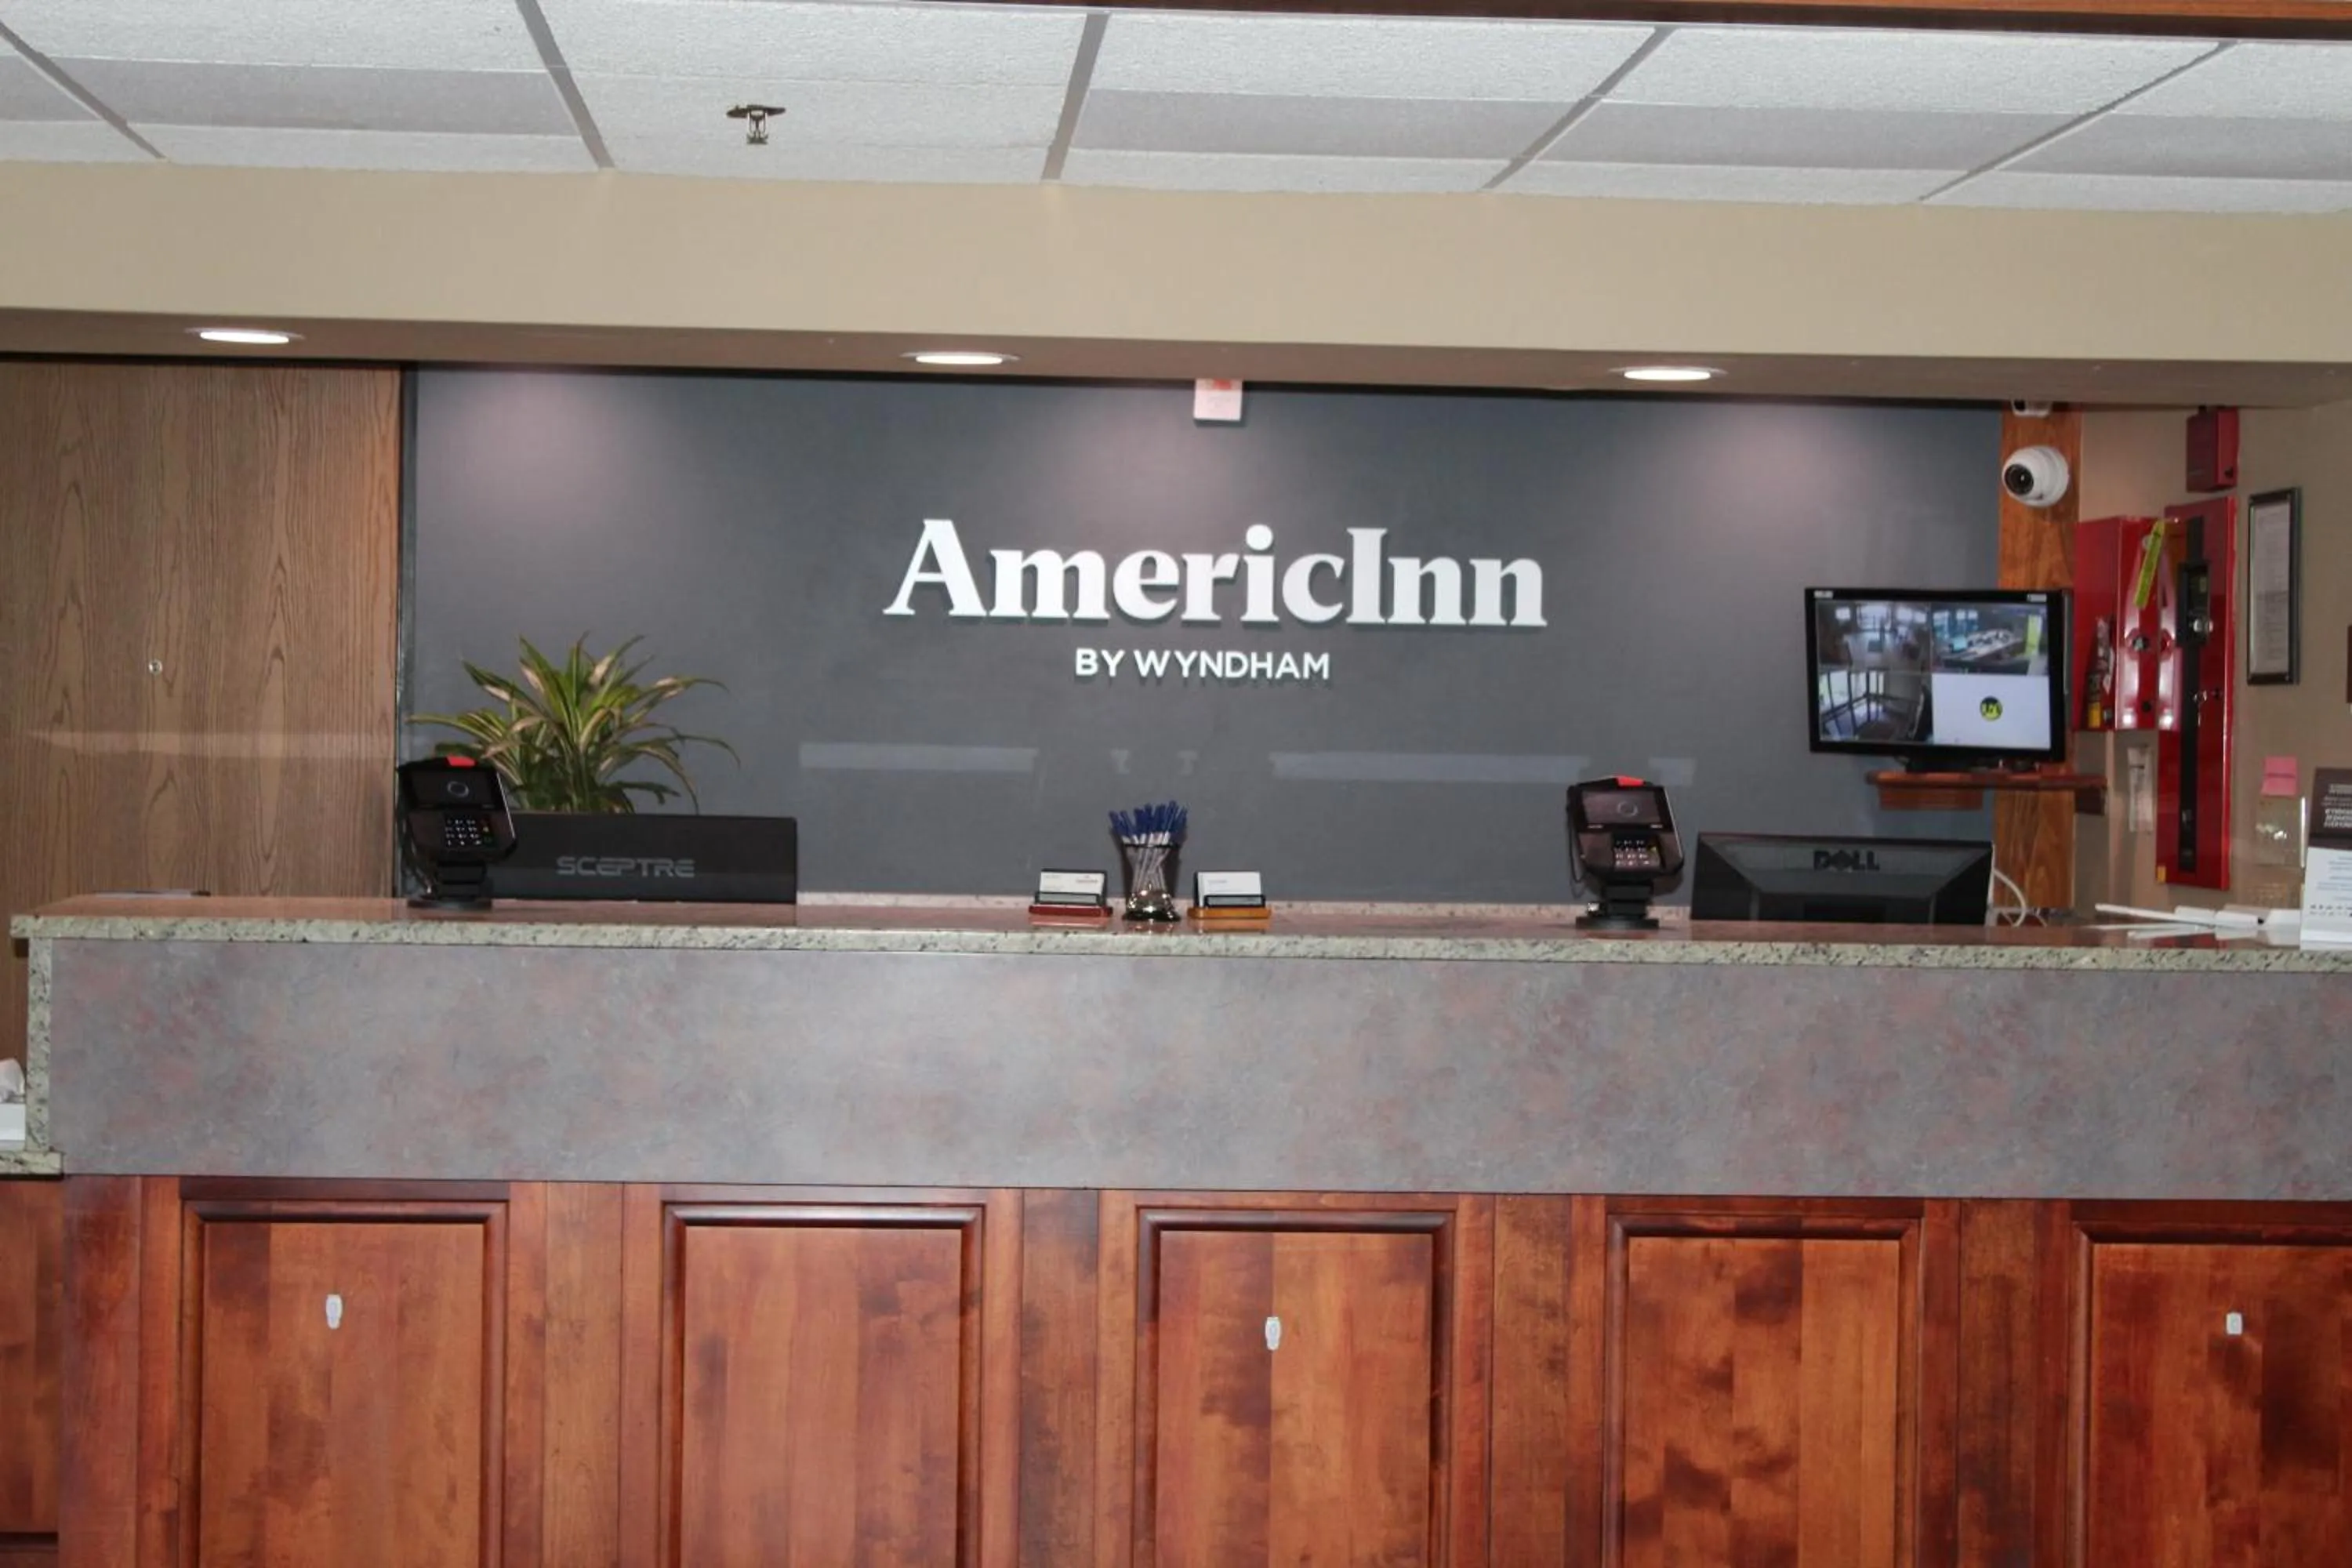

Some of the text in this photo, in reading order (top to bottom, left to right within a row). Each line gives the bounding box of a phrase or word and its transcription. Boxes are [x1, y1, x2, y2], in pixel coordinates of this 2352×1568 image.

[883, 518, 1548, 626] AmericInn
[1074, 648, 1330, 680] BY WYNDHAM
[556, 855, 695, 878] SCEPTRE
[1813, 850, 1881, 871] DELL
